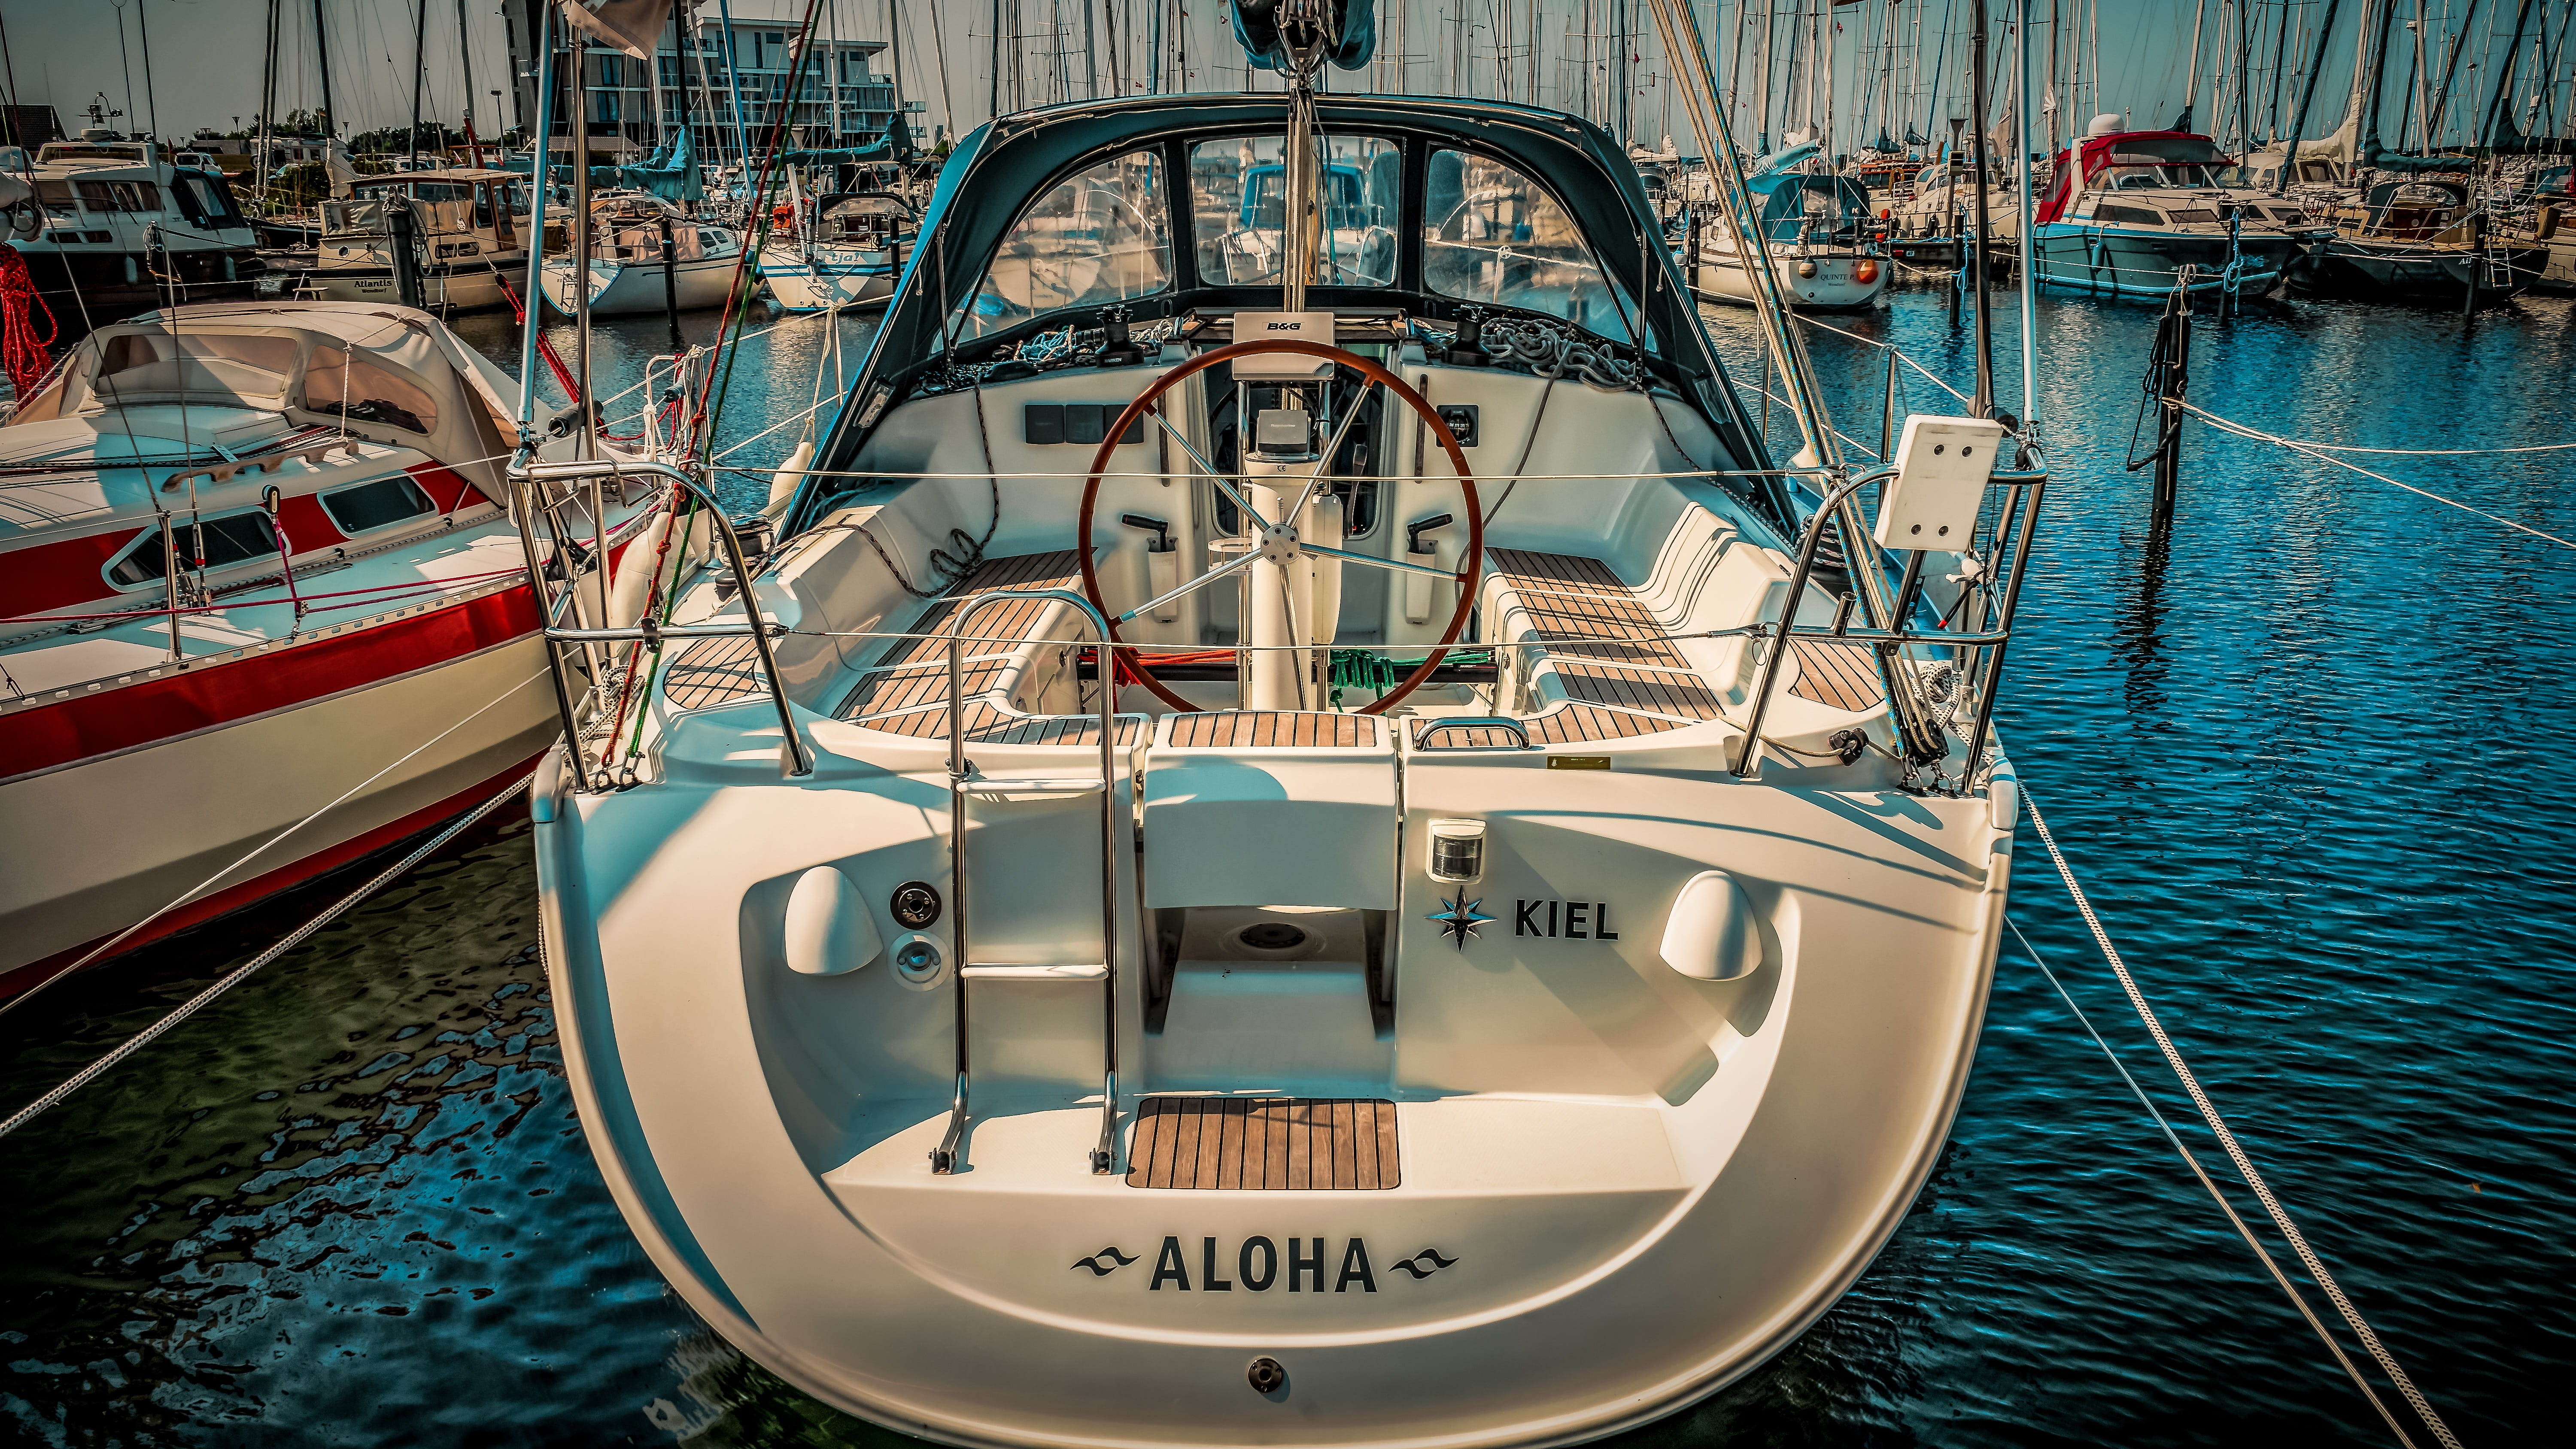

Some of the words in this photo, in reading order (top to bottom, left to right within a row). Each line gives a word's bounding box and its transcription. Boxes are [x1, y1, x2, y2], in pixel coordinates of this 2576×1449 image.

[832, 252, 860, 264] tja!
[354, 279, 392, 288] Atlantis
[1267, 322, 1301, 330] B&G
[1514, 898, 1619, 941] KIEL
[1149, 1235, 1378, 1293] ALOHA
